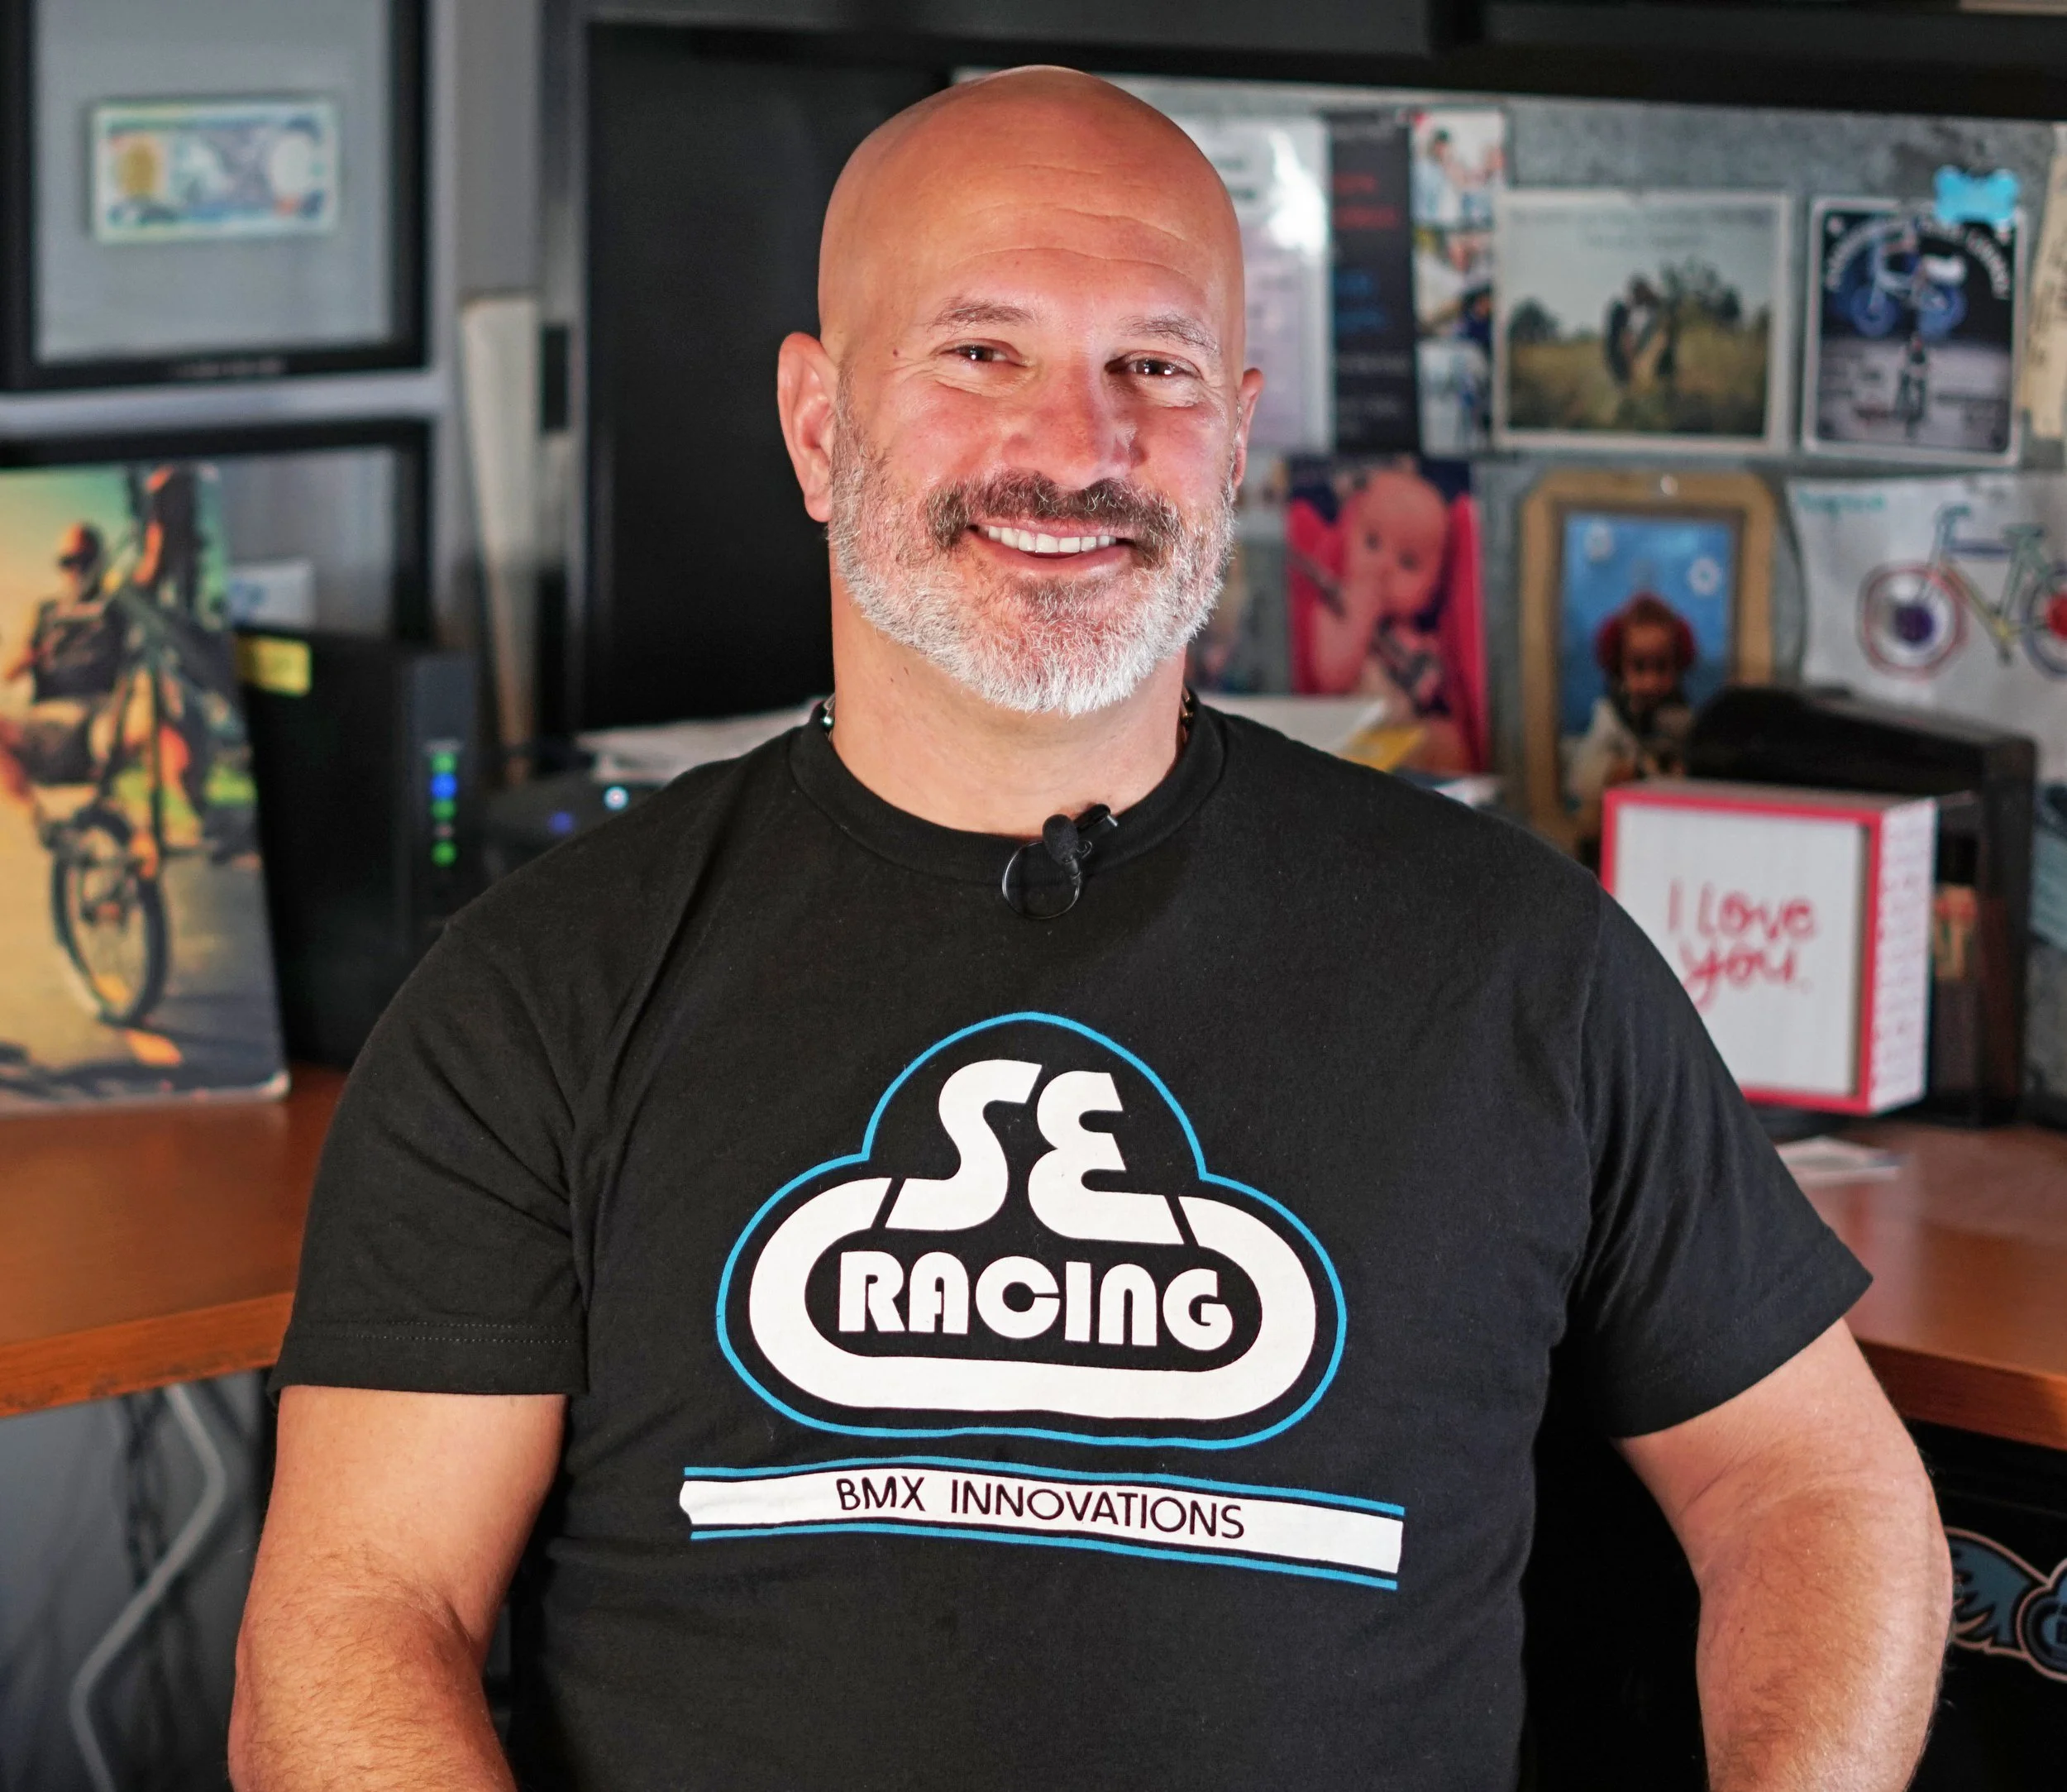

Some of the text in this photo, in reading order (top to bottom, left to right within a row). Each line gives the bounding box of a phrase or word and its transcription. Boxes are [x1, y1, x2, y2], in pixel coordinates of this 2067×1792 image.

[1667, 880, 1683, 933] I
[886, 1059, 1184, 1245] SE
[839, 1251, 1233, 1350] RACING
[836, 1476, 1244, 1539] BMX INNOVATIONS
